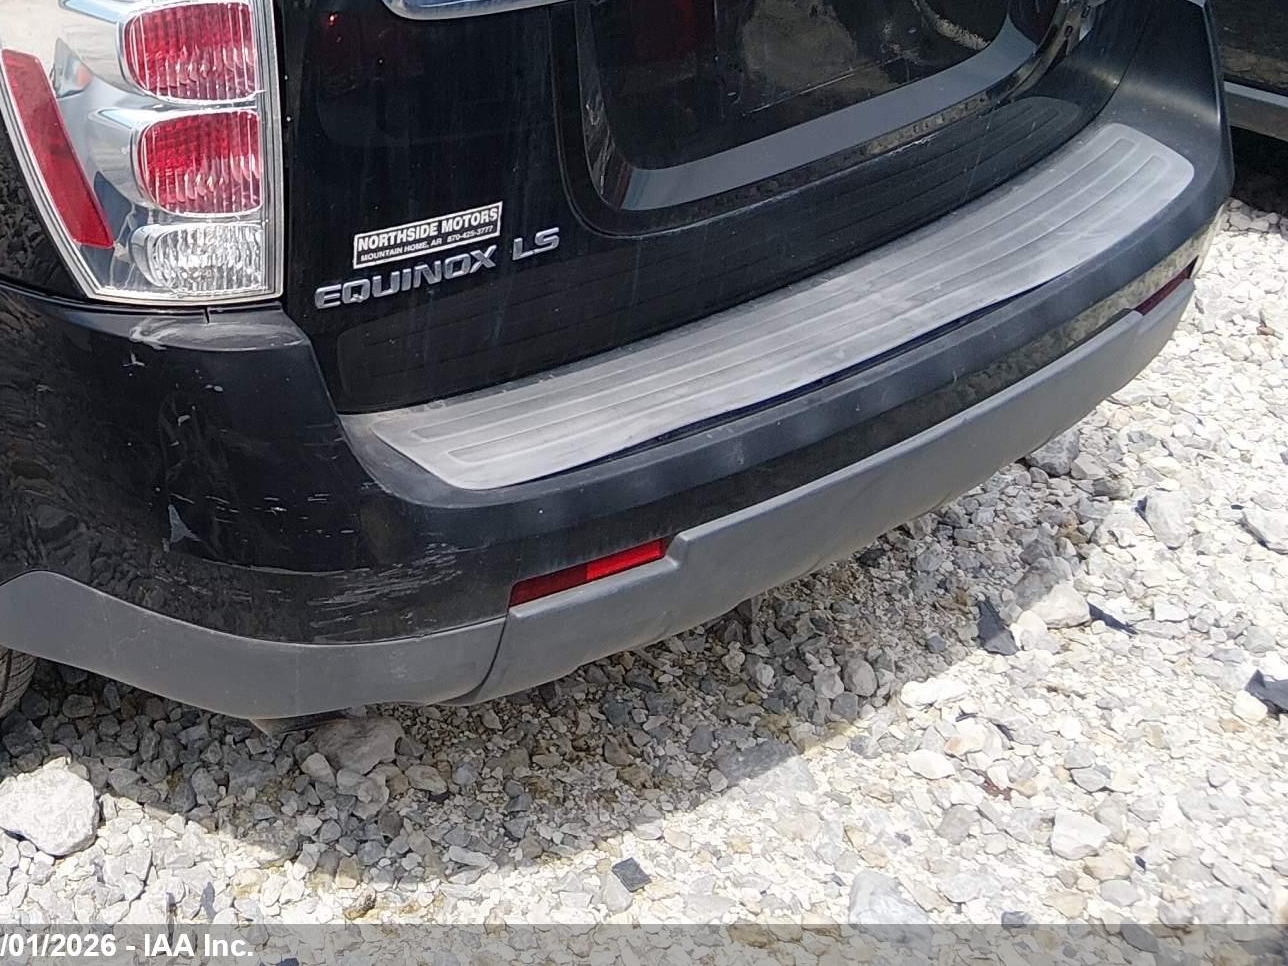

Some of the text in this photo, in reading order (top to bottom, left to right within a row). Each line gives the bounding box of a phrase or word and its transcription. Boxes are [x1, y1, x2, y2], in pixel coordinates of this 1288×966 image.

[357, 207, 498, 252] NORTHSIDE MOTORS
[360, 246, 403, 262] MOUNTAIN
[430, 237, 442, 246] AR
[314, 227, 560, 310] EQUINOX LS
